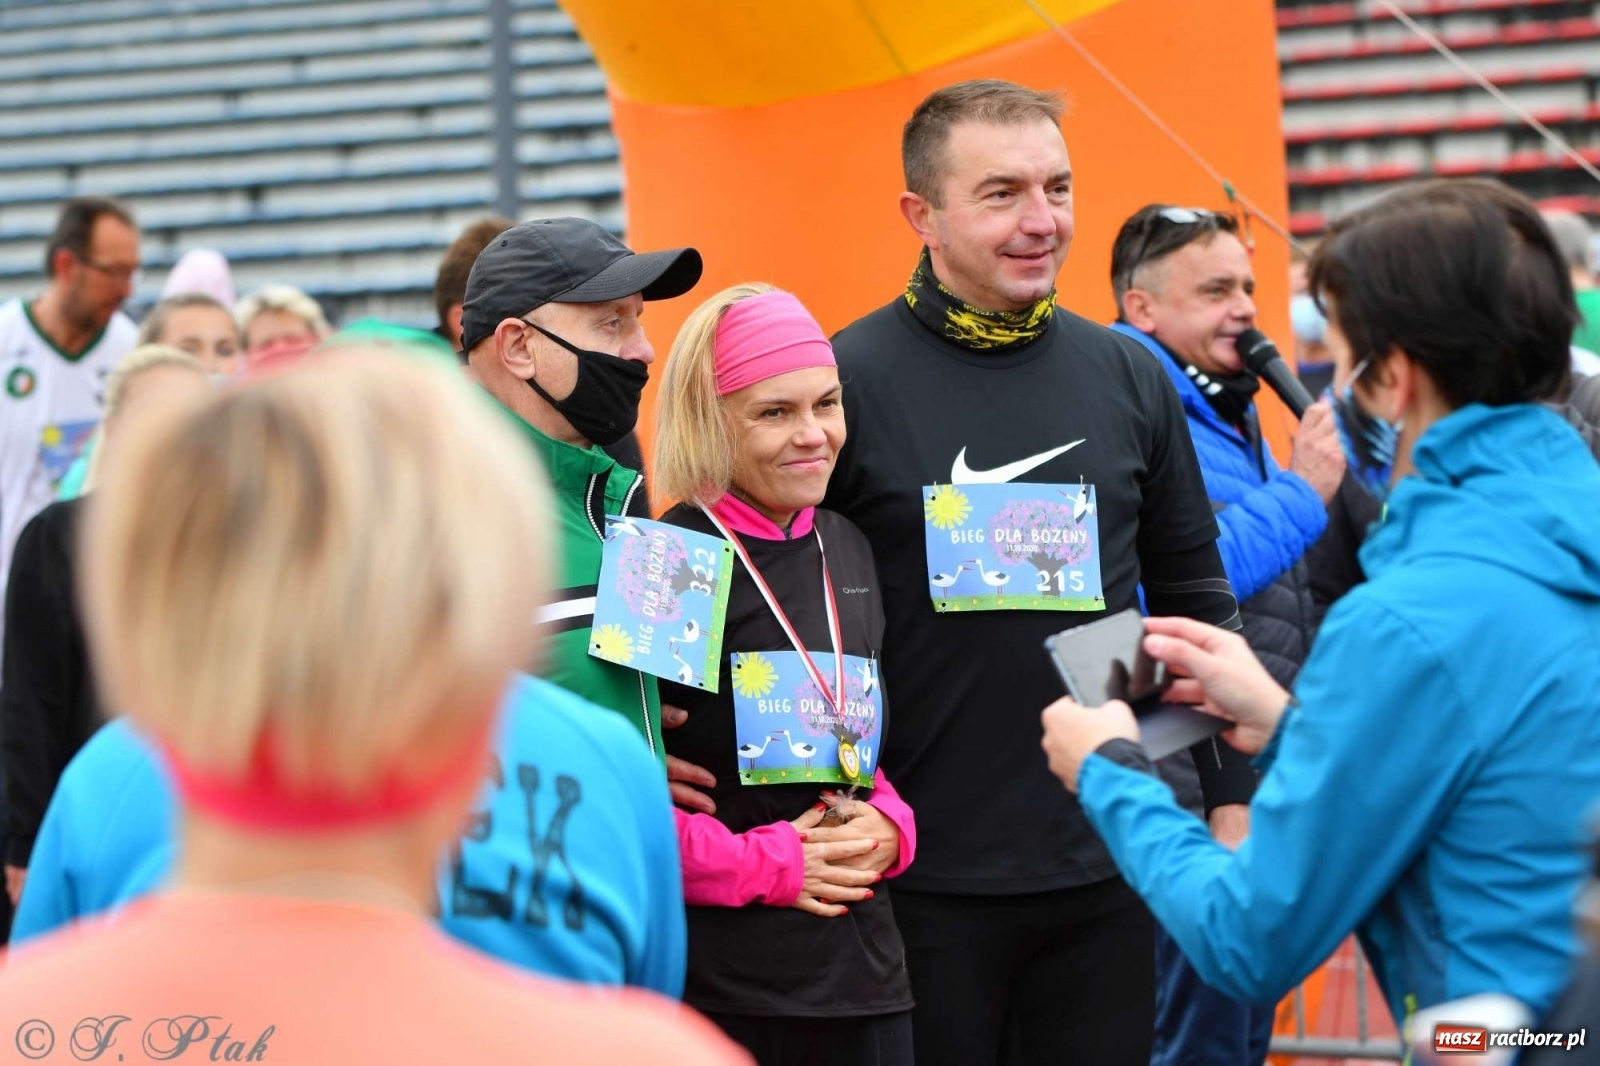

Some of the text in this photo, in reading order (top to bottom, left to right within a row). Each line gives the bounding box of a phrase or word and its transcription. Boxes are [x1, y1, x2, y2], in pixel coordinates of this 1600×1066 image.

[951, 528, 1087, 544] BIEG DLA BOŻENY
[689, 547, 716, 597] 322
[1036, 570, 1085, 592] 215
[642, 590, 660, 618] DLA
[636, 624, 654, 655] BIEG
[758, 699, 792, 714] BIEG
[800, 699, 825, 714] DLA
